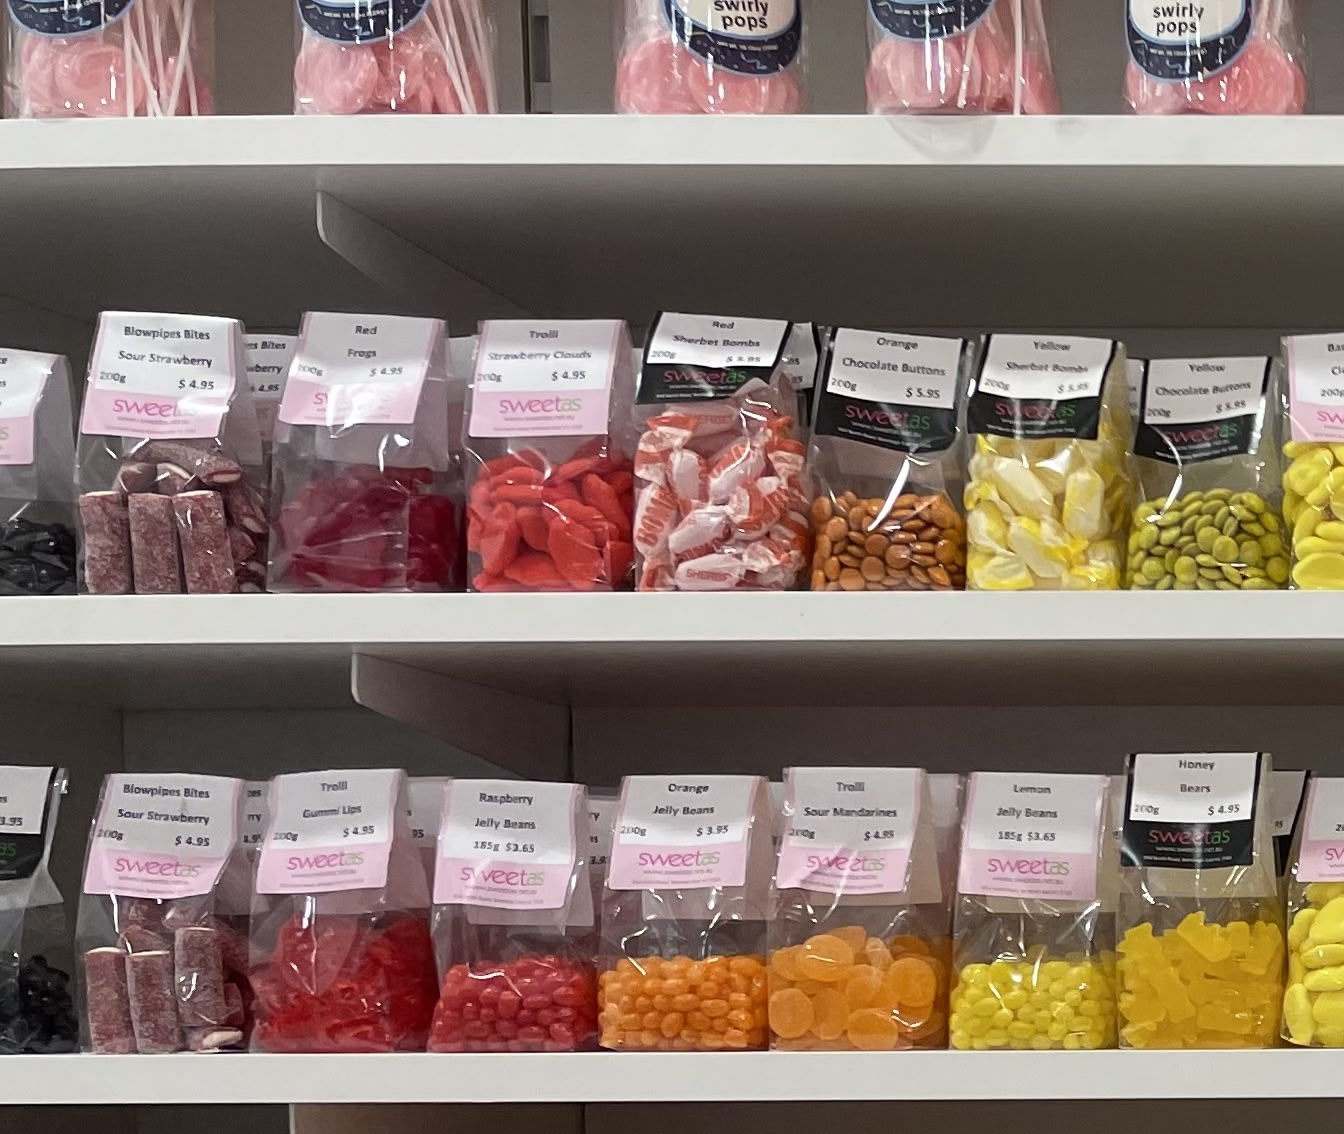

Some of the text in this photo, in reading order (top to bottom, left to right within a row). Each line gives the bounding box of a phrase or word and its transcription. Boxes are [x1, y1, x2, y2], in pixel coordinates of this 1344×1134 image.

[1153, 3, 1204, 20] swirly
[722, 13, 768, 29] pops
[1156, 19, 1197, 35] pops
[713, 321, 734, 330] Red
[125, 326, 210, 341] Blowpipes Bites
[673, 335, 760, 347] Sherbet Bombs
[877, 337, 918, 350] Orange
[119, 351, 212, 368] Sour Strawberry
[488, 350, 592, 361] Strawberry Clouds
[842, 358, 946, 377] Chocolate Buttons
[500, 397, 582, 414] sweetas
[1179, 759, 1214, 771] Honey
[668, 783, 709, 794] Orange
[1013, 785, 1051, 794] Lemon
[1180, 783, 1210, 793] Bears
[479, 793, 533, 806] Raspberry
[303, 805, 361, 818] Gummi Lips
[653, 804, 714, 816] Jelly Beans
[997, 806, 1057, 819] Jelly Beans
[475, 818, 536, 830] Jelly Beans
[998, 831, 1056, 842] 185g $3.65
[1148, 829, 1230, 845] sweetas
[288, 851, 364, 869] sweetas
